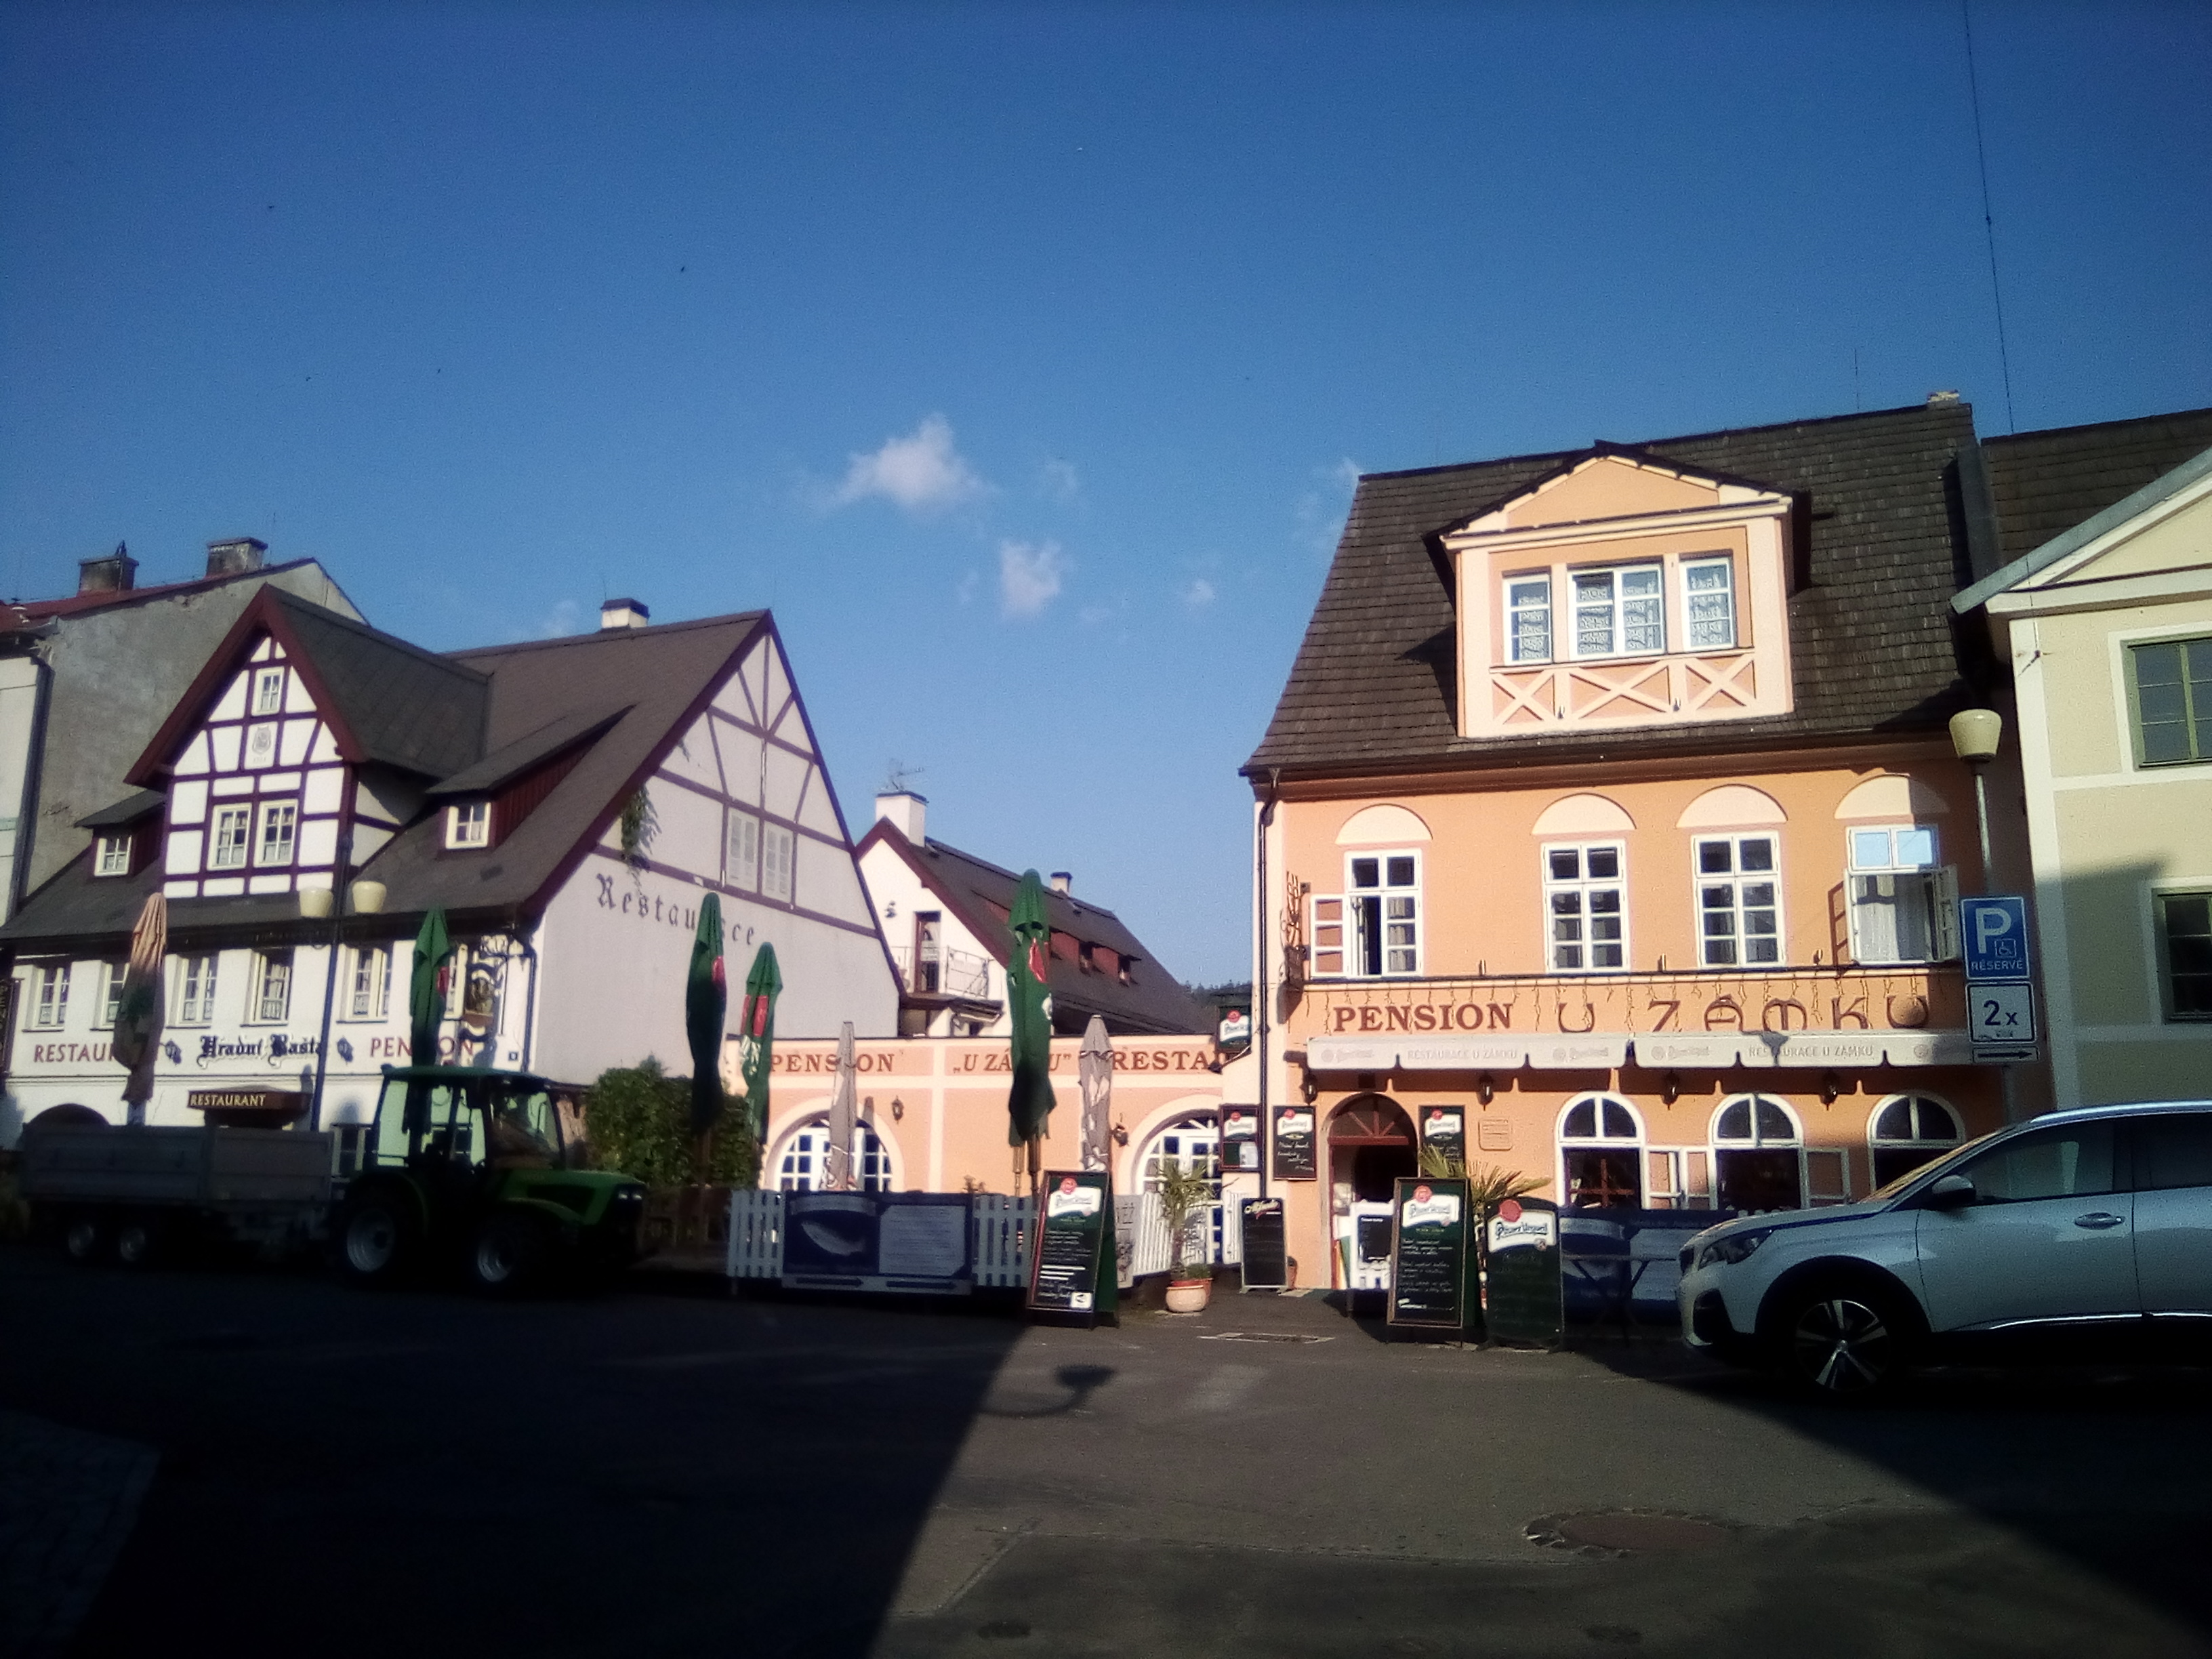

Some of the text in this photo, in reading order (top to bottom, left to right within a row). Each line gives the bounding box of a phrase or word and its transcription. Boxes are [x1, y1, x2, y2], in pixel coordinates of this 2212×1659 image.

[596, 873, 754, 945] Restauce
[1975, 907, 2011, 954] P
[1332, 1003, 1513, 1032] PENSION
[1558, 1002, 1595, 1033] U
[33, 1043, 115, 1063] RESTAU
[370, 1036, 474, 1057] PENON
[1748, 1046, 1817, 1058] RESURACE
[771, 1053, 895, 1073] PENSON
[189, 1094, 266, 1107] RESTAURANT
